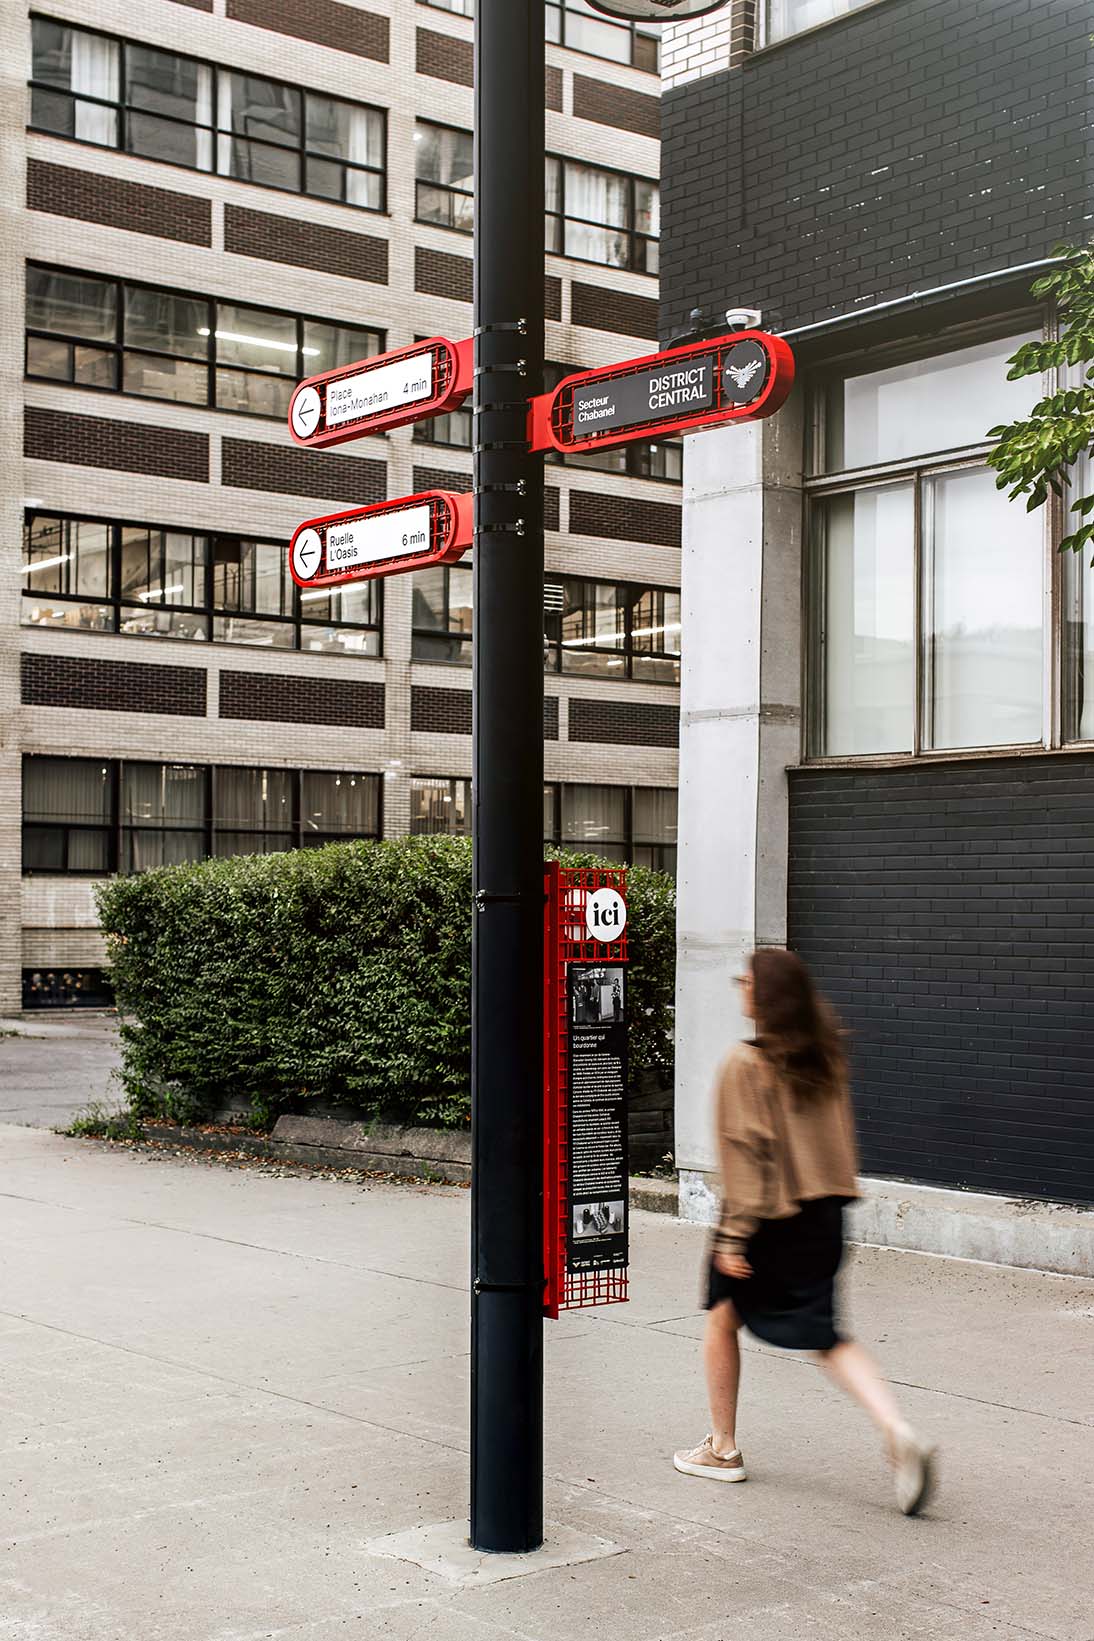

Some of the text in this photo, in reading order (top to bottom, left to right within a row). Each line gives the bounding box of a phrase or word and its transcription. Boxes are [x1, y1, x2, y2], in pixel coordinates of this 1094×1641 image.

[402, 378, 427, 394] 4 min
[649, 366, 706, 394] DISTRICT
[330, 387, 353, 401] Place
[648, 384, 707, 410] CENTRAL
[330, 390, 389, 416] Iona-Monahan
[578, 395, 609, 411] Secteur
[578, 404, 615, 423] Chabanel
[329, 532, 354, 547] Ruelle
[402, 530, 426, 546] 6 min
[329, 546, 358, 562] L'Oasis
[593, 901, 620, 927] ici
